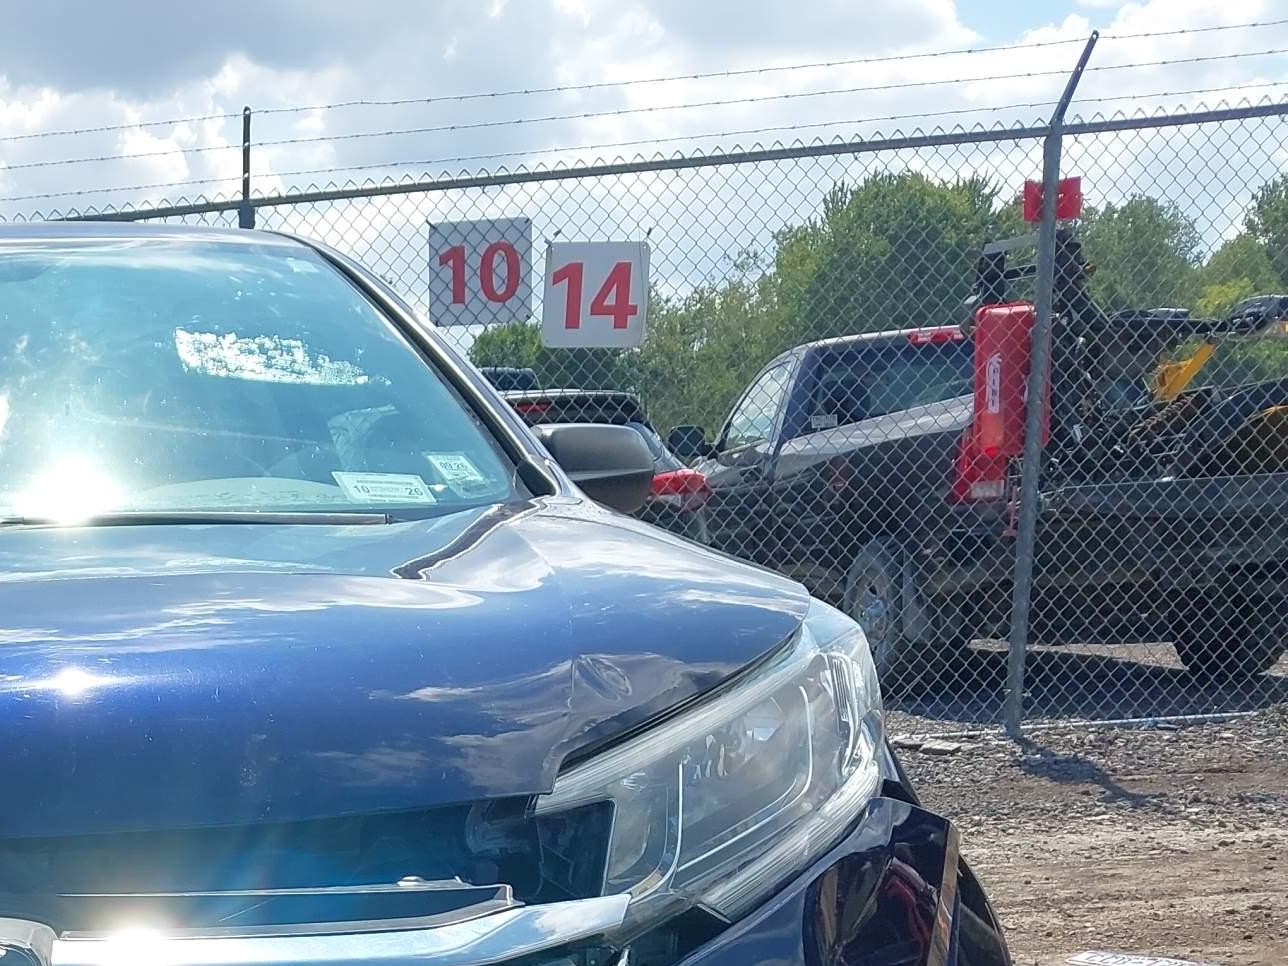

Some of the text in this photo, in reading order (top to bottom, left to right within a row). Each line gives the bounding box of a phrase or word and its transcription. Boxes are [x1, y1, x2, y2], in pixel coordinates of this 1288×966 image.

[438, 241, 521, 305] 10
[551, 261, 638, 330] 14
[353, 485, 424, 496] 10 26
